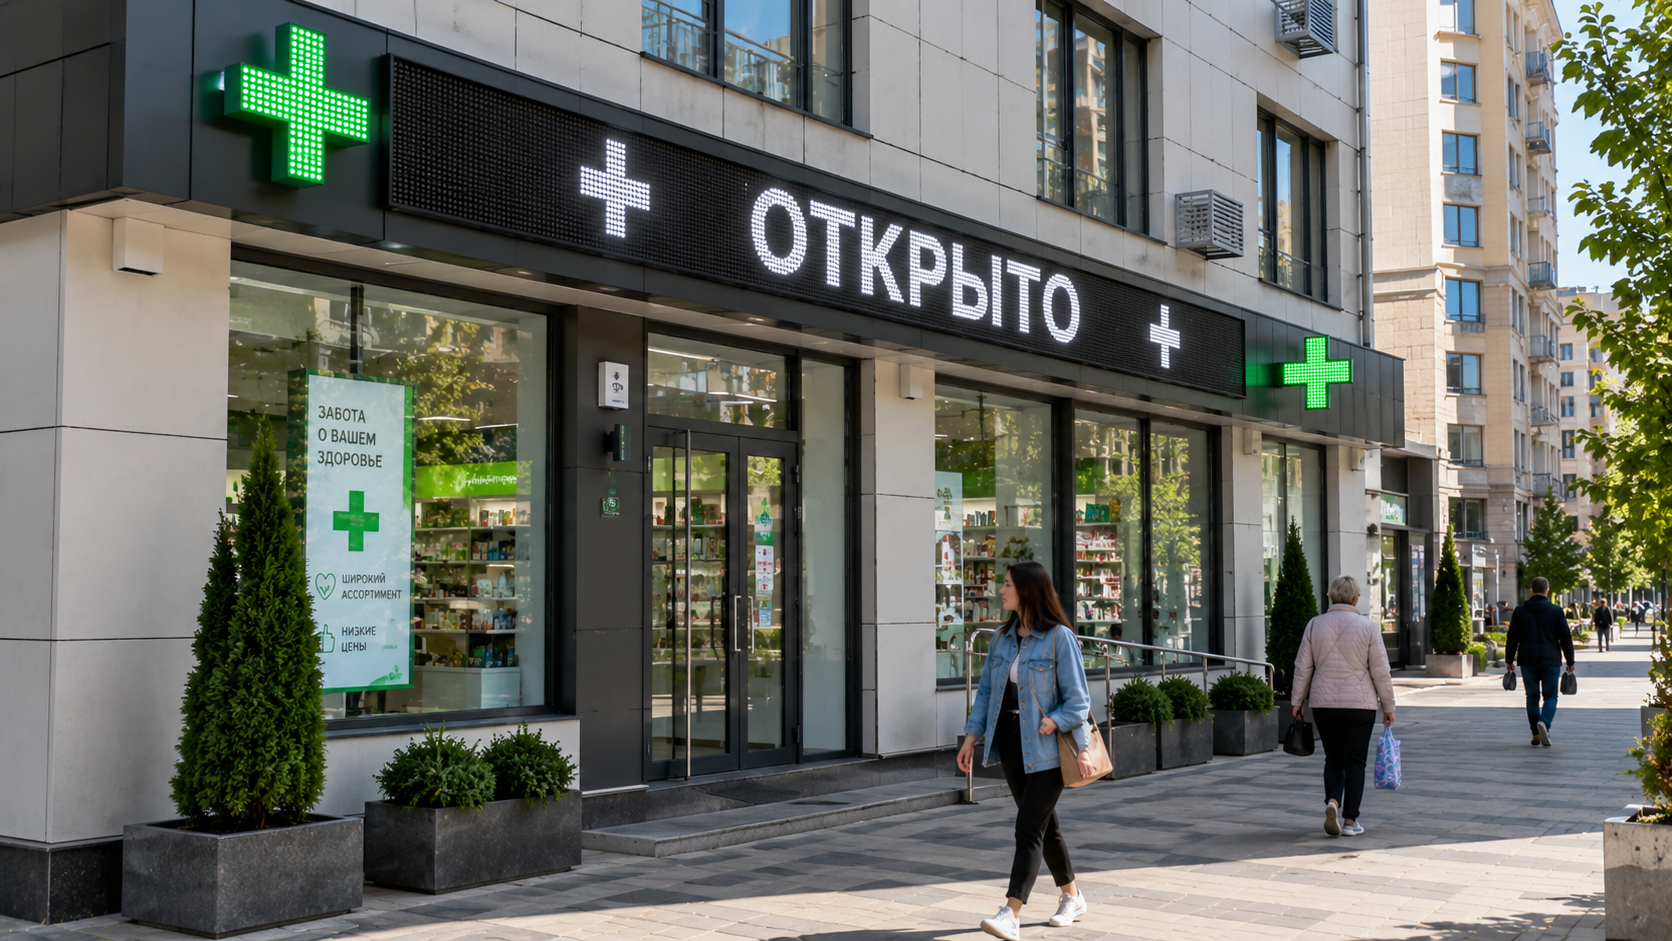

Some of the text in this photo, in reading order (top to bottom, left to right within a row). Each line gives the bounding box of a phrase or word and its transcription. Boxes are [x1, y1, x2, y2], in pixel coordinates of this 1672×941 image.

[751, 187, 1080, 344] ОТКРЫТО
[318, 405, 366, 424] ЗАБОТА
[318, 428, 376, 446] О ВАШЕМ
[317, 450, 383, 468] ЗДОРОВЬЕ
[342, 572, 386, 584] ШИРОКИЙ
[341, 589, 402, 600] АССОРТИМЕНТ
[341, 626, 377, 636] НИЗКИЕ
[341, 642, 367, 653] ЦЕНЫ
